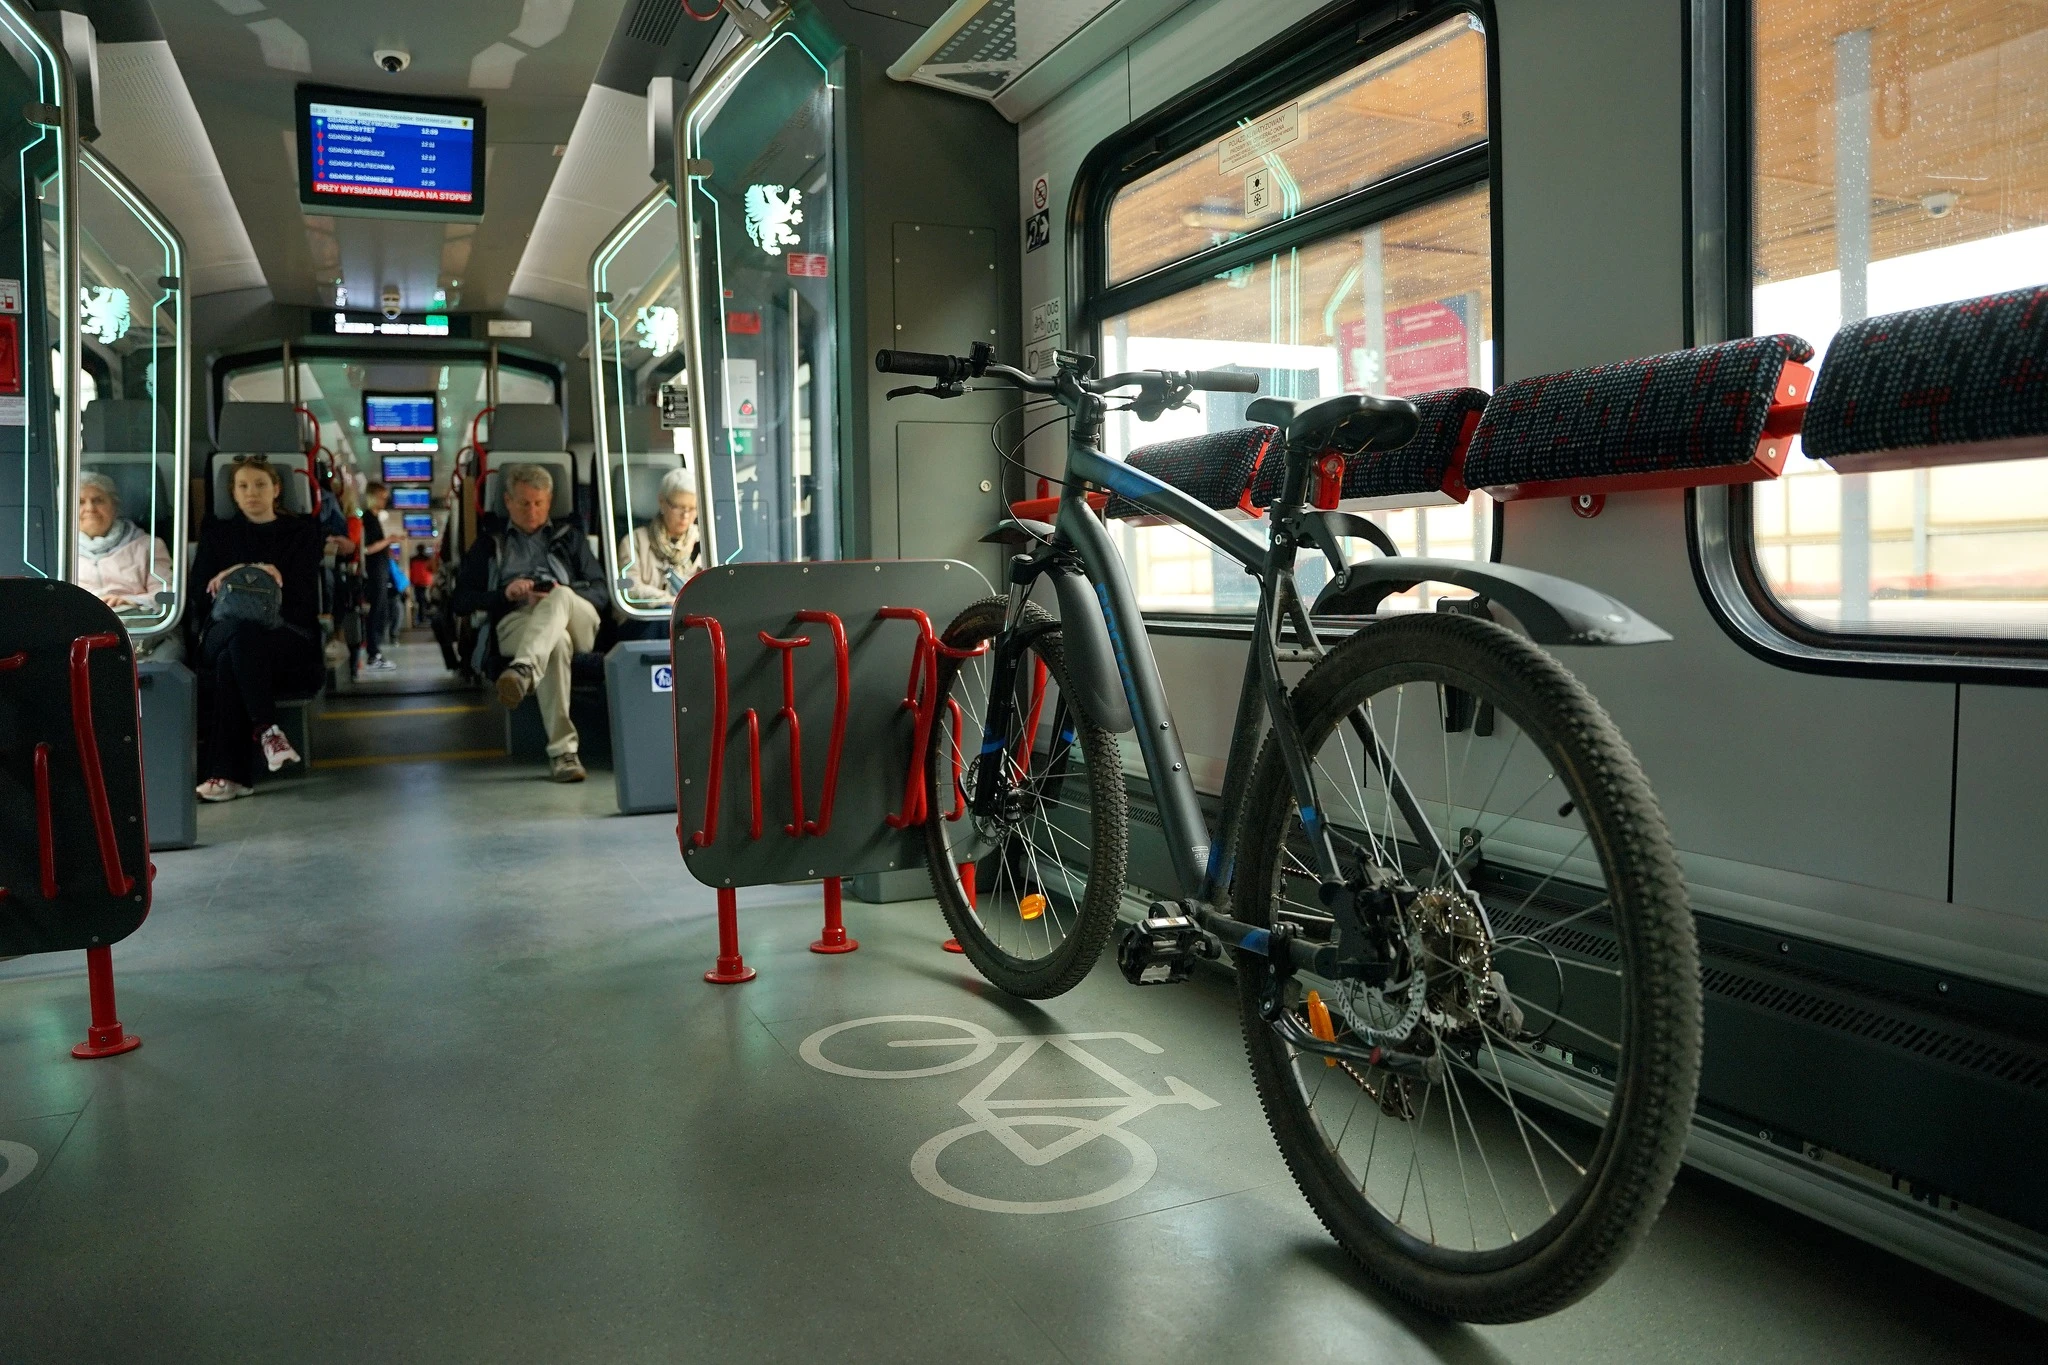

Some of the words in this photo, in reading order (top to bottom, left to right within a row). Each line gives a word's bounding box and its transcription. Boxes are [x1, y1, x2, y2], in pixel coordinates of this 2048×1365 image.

[316, 183, 339, 193] PRZY
[340, 185, 393, 197] WYSIADANIU
[394, 189, 425, 199] UWAGA
[426, 191, 439, 200] NA
